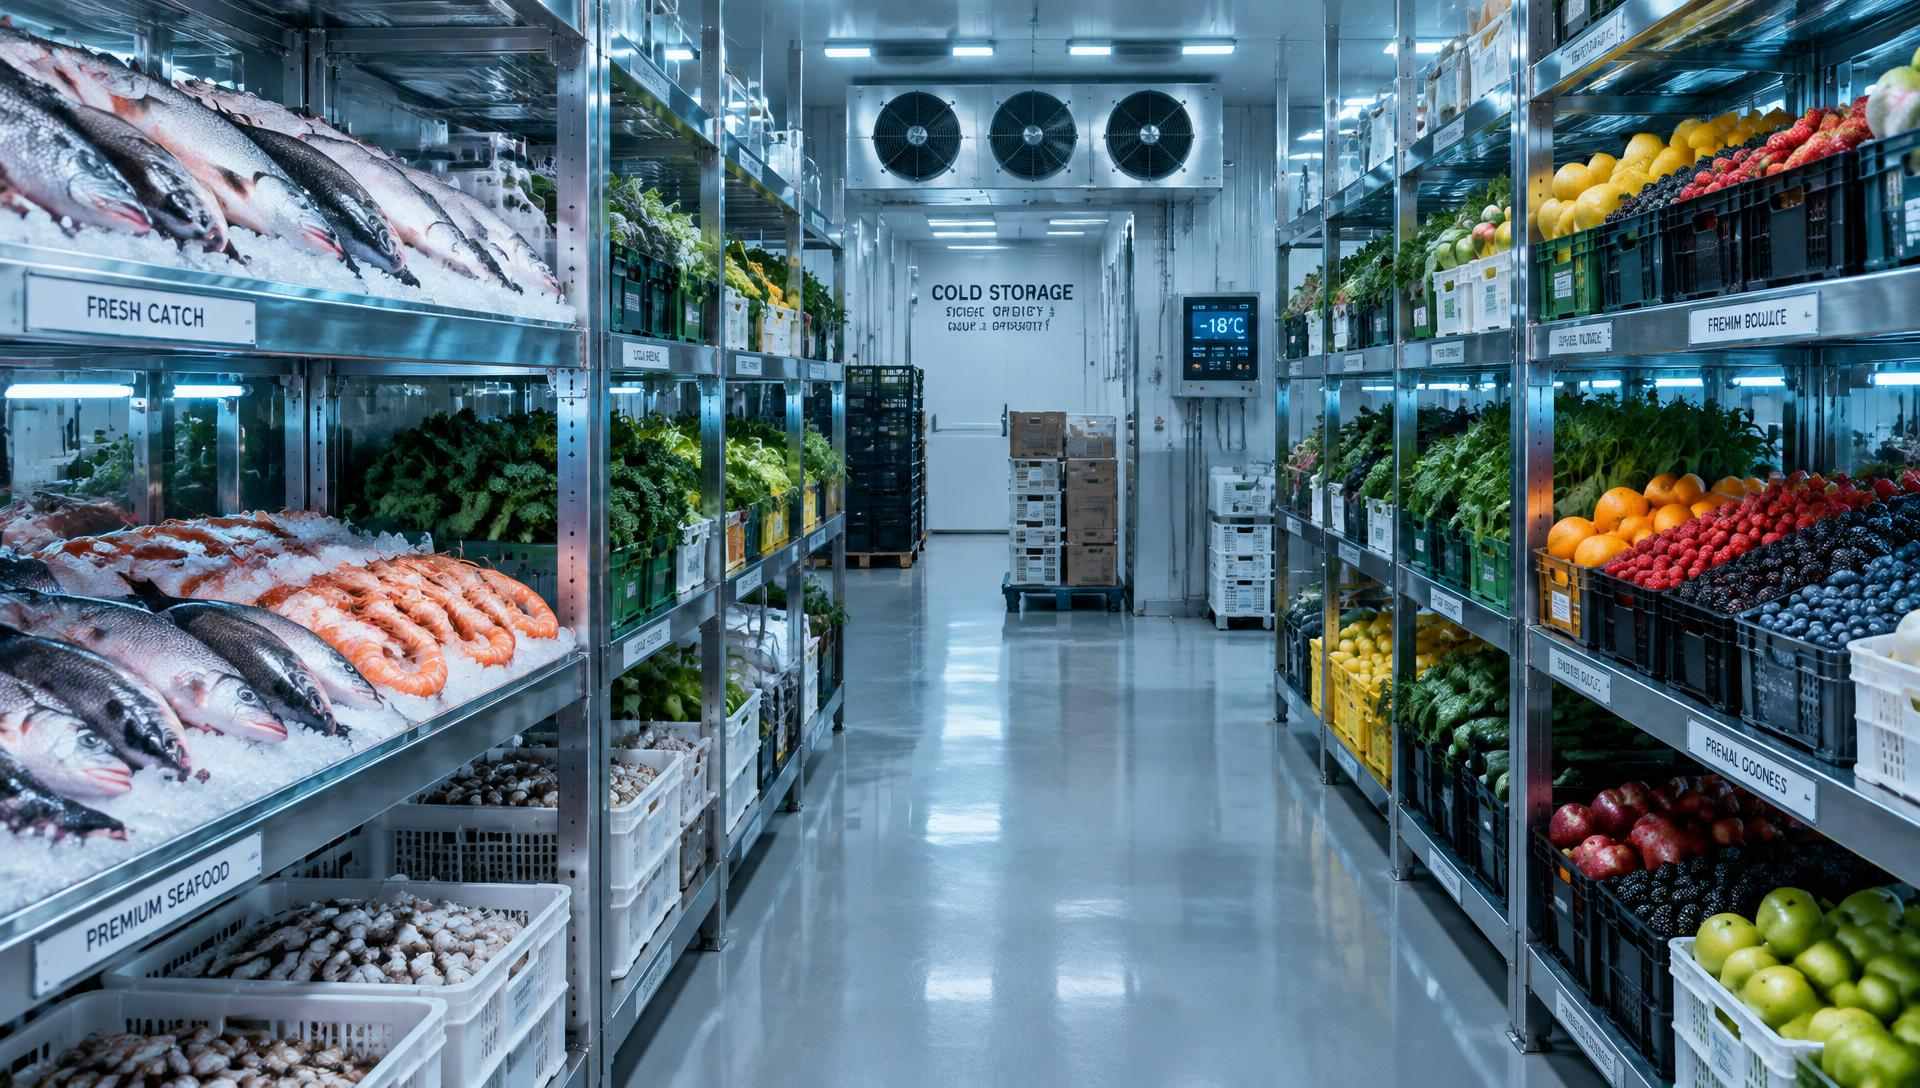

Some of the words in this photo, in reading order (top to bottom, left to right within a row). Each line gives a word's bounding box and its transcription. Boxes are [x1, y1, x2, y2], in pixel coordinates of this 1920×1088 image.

[932, 284, 982, 301] COLD
[990, 284, 1074, 301] STORAGE
[87, 296, 141, 322] FRESH
[148, 303, 204, 328] CATCH
[86, 895, 162, 952] PREMIUM
[168, 861, 230, 909] SEAFOOD
